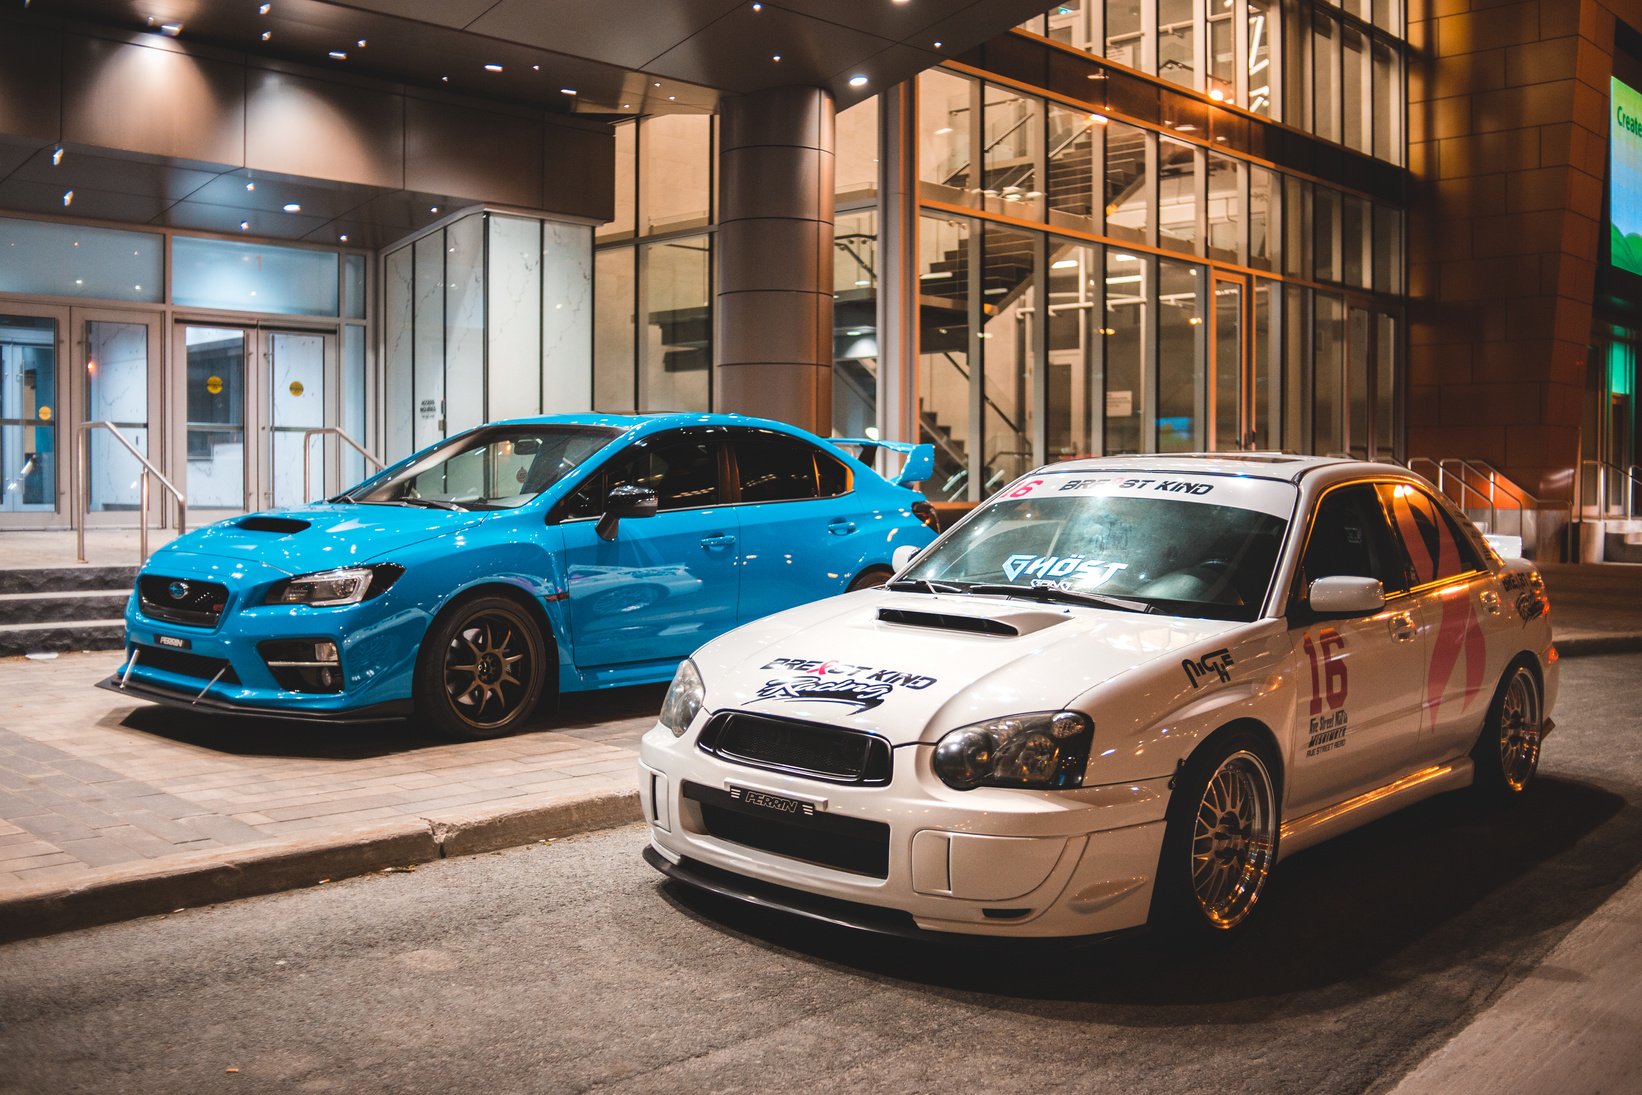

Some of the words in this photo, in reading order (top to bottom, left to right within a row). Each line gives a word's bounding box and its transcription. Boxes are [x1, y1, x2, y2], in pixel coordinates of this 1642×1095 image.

[1058, 477, 1156, 492] BREST
[1154, 481, 1214, 496] KIND
[866, 669, 938, 691] KIND
[1303, 628, 1347, 716] 16
[745, 790, 798, 813] PERRIN
